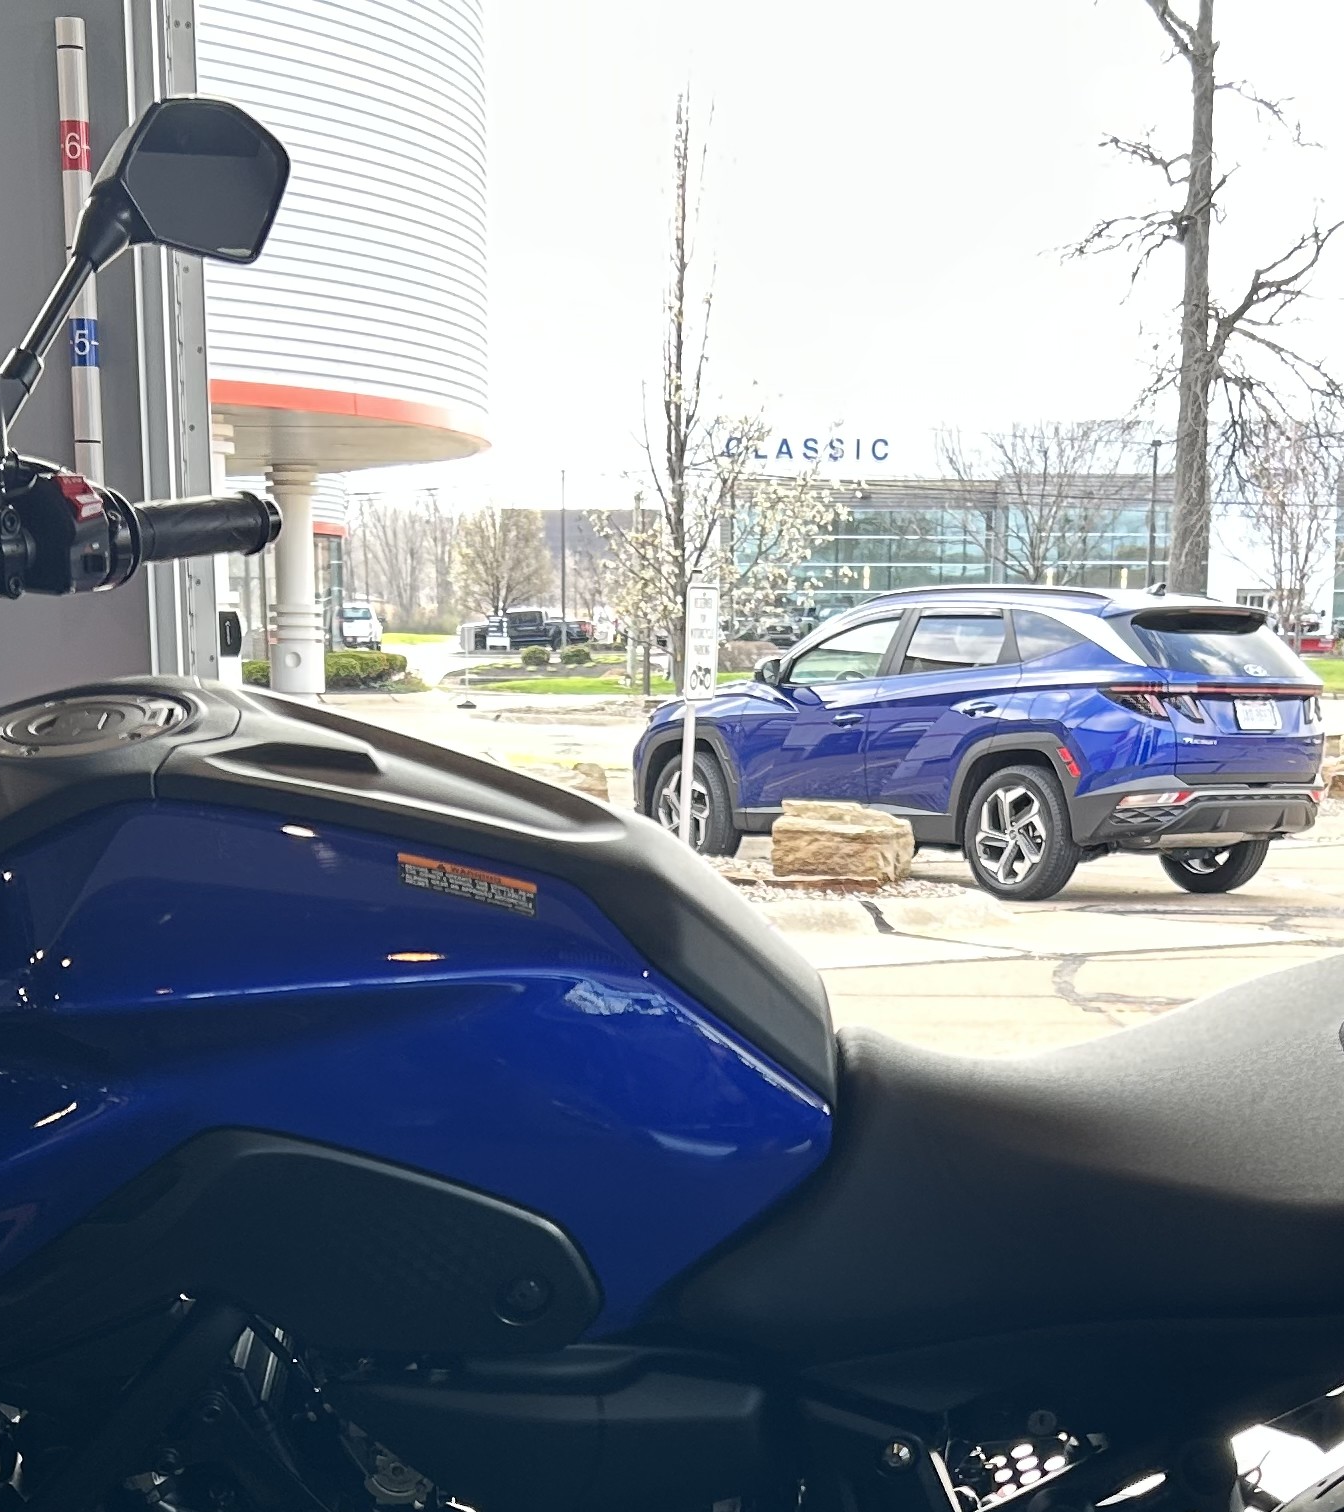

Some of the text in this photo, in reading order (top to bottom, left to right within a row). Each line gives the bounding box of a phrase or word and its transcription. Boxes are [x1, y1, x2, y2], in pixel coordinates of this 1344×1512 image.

[64, 132, 81, 160] 6
[73, 329, 90, 356] 5
[724, 436, 889, 462] CLASSIC
